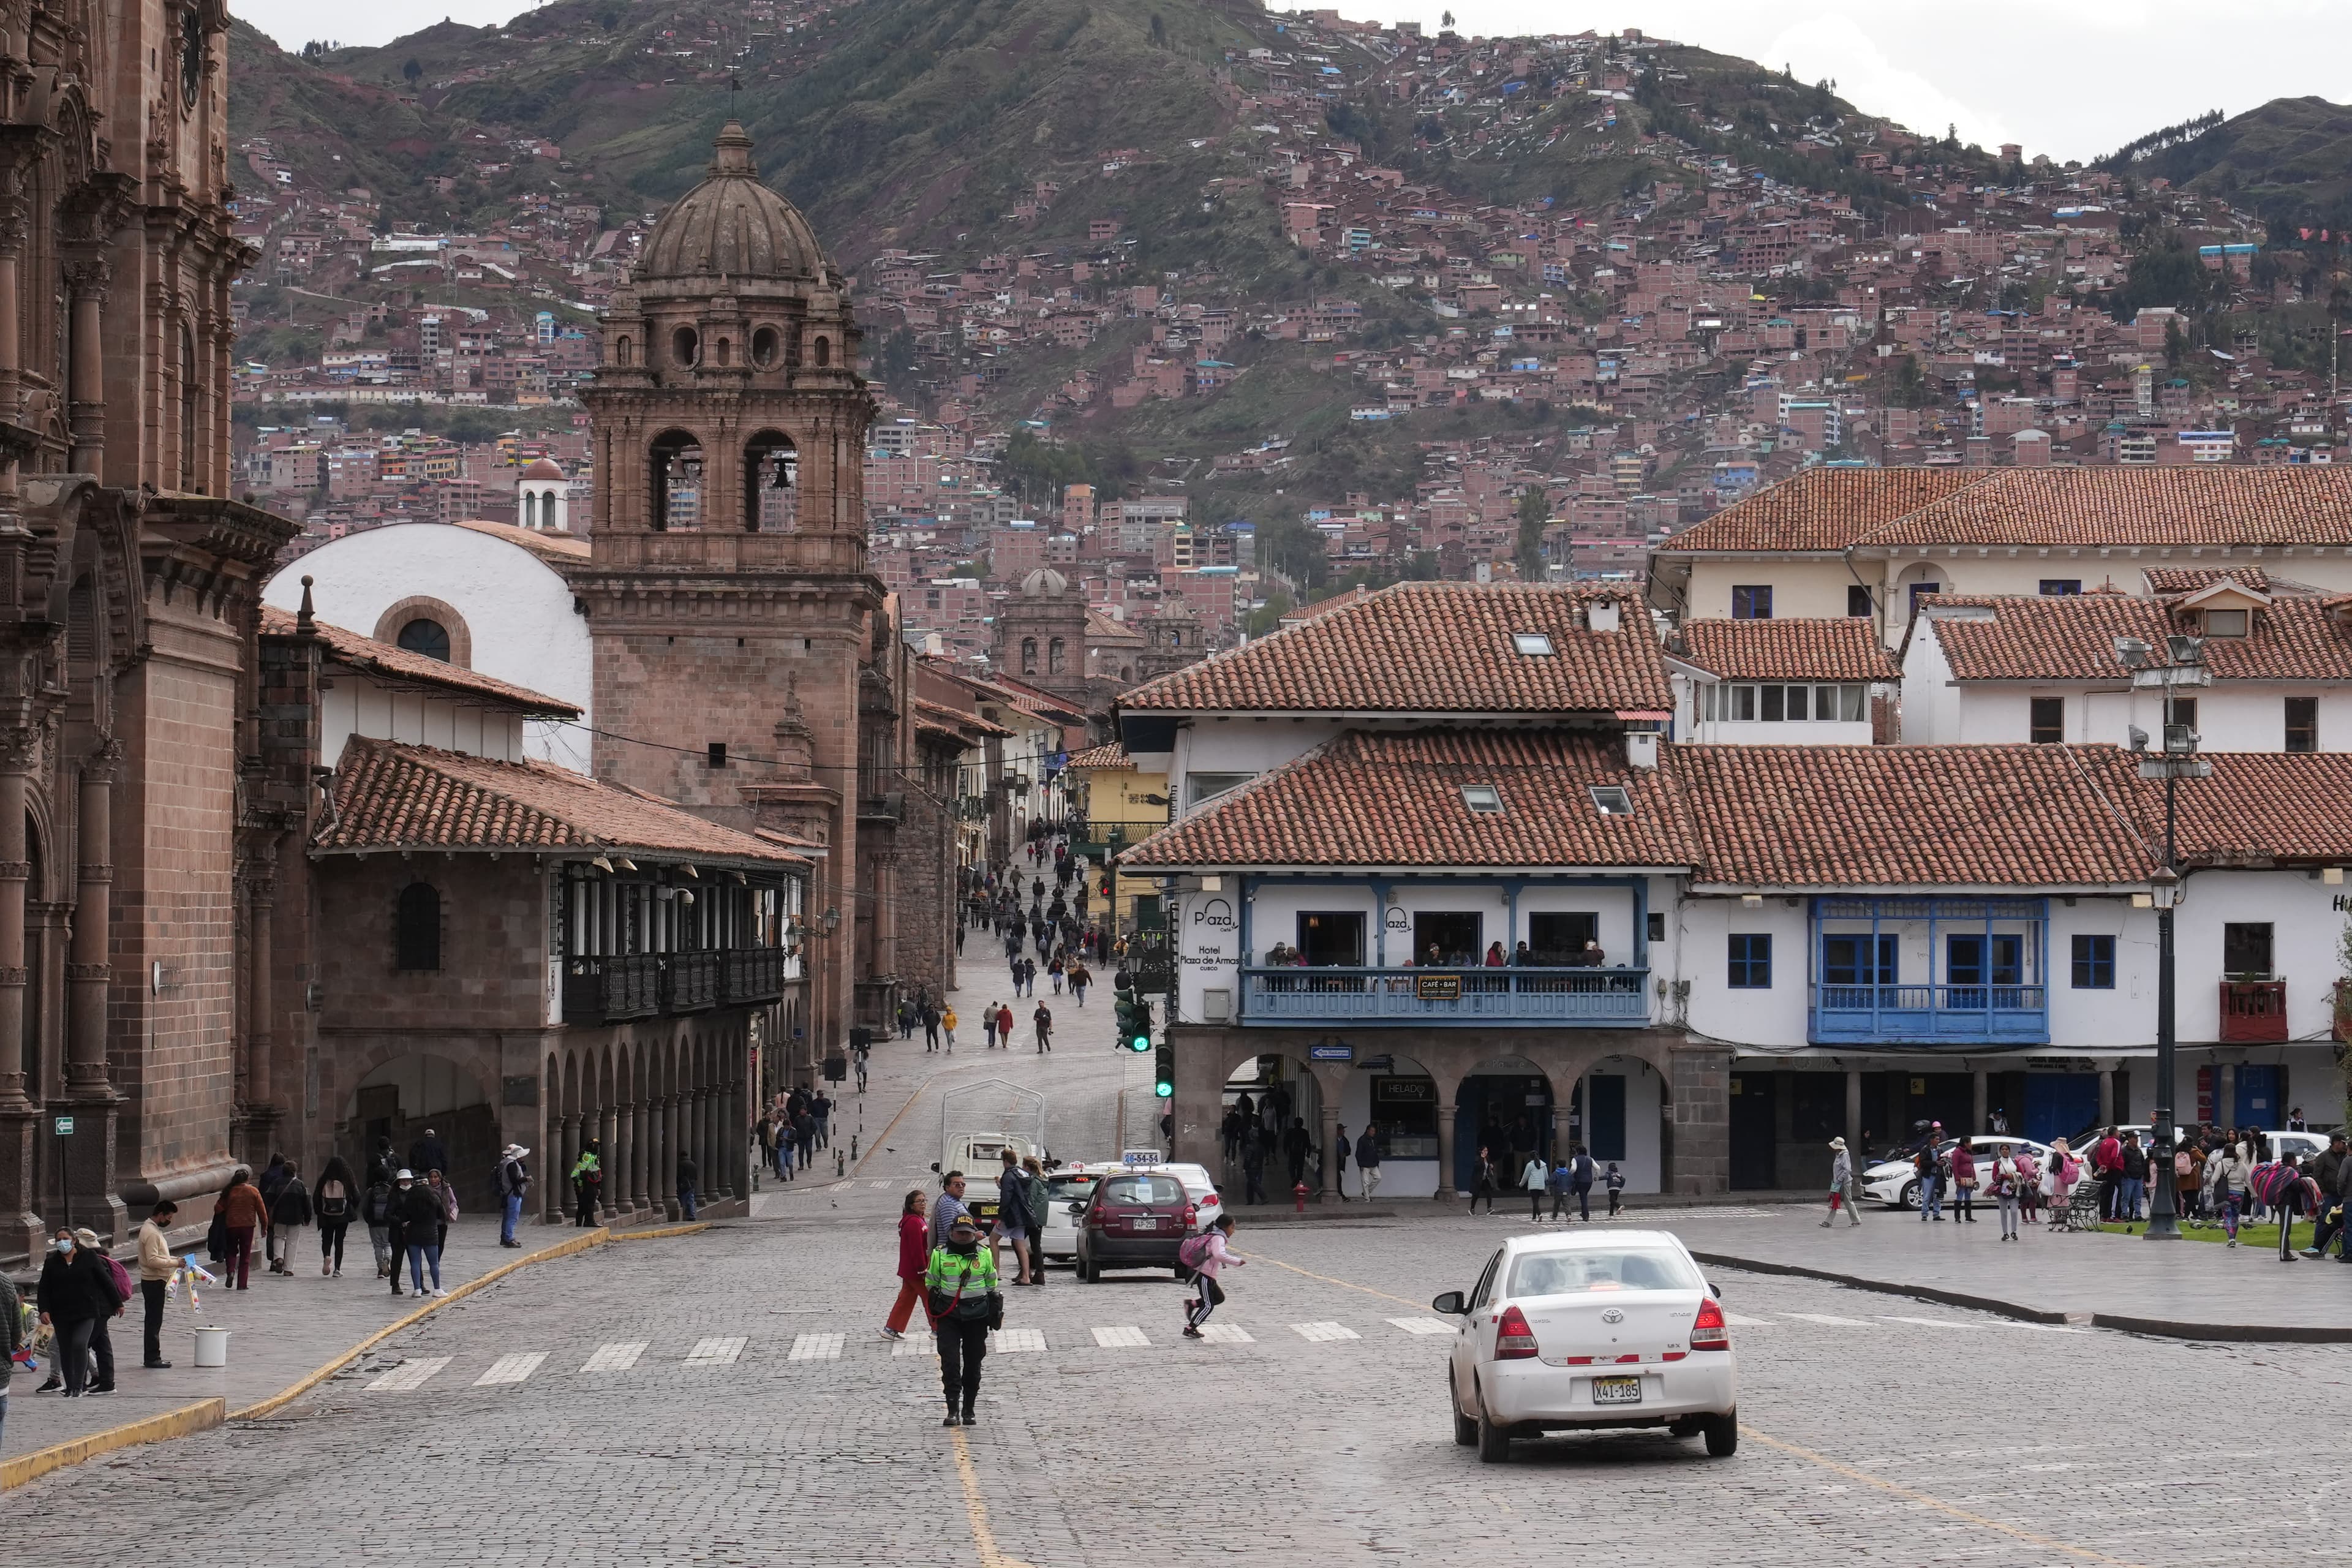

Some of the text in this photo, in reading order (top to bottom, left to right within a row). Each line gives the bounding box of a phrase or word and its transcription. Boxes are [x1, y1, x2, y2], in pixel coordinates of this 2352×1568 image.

[1199, 945, 1221, 954] Hotel
[1180, 956, 1200, 964] Plaza
[1202, 956, 1213, 964] de
[957, 1215, 973, 1226] POLICIA
[1596, 1384, 1638, 1399] X4I-185
